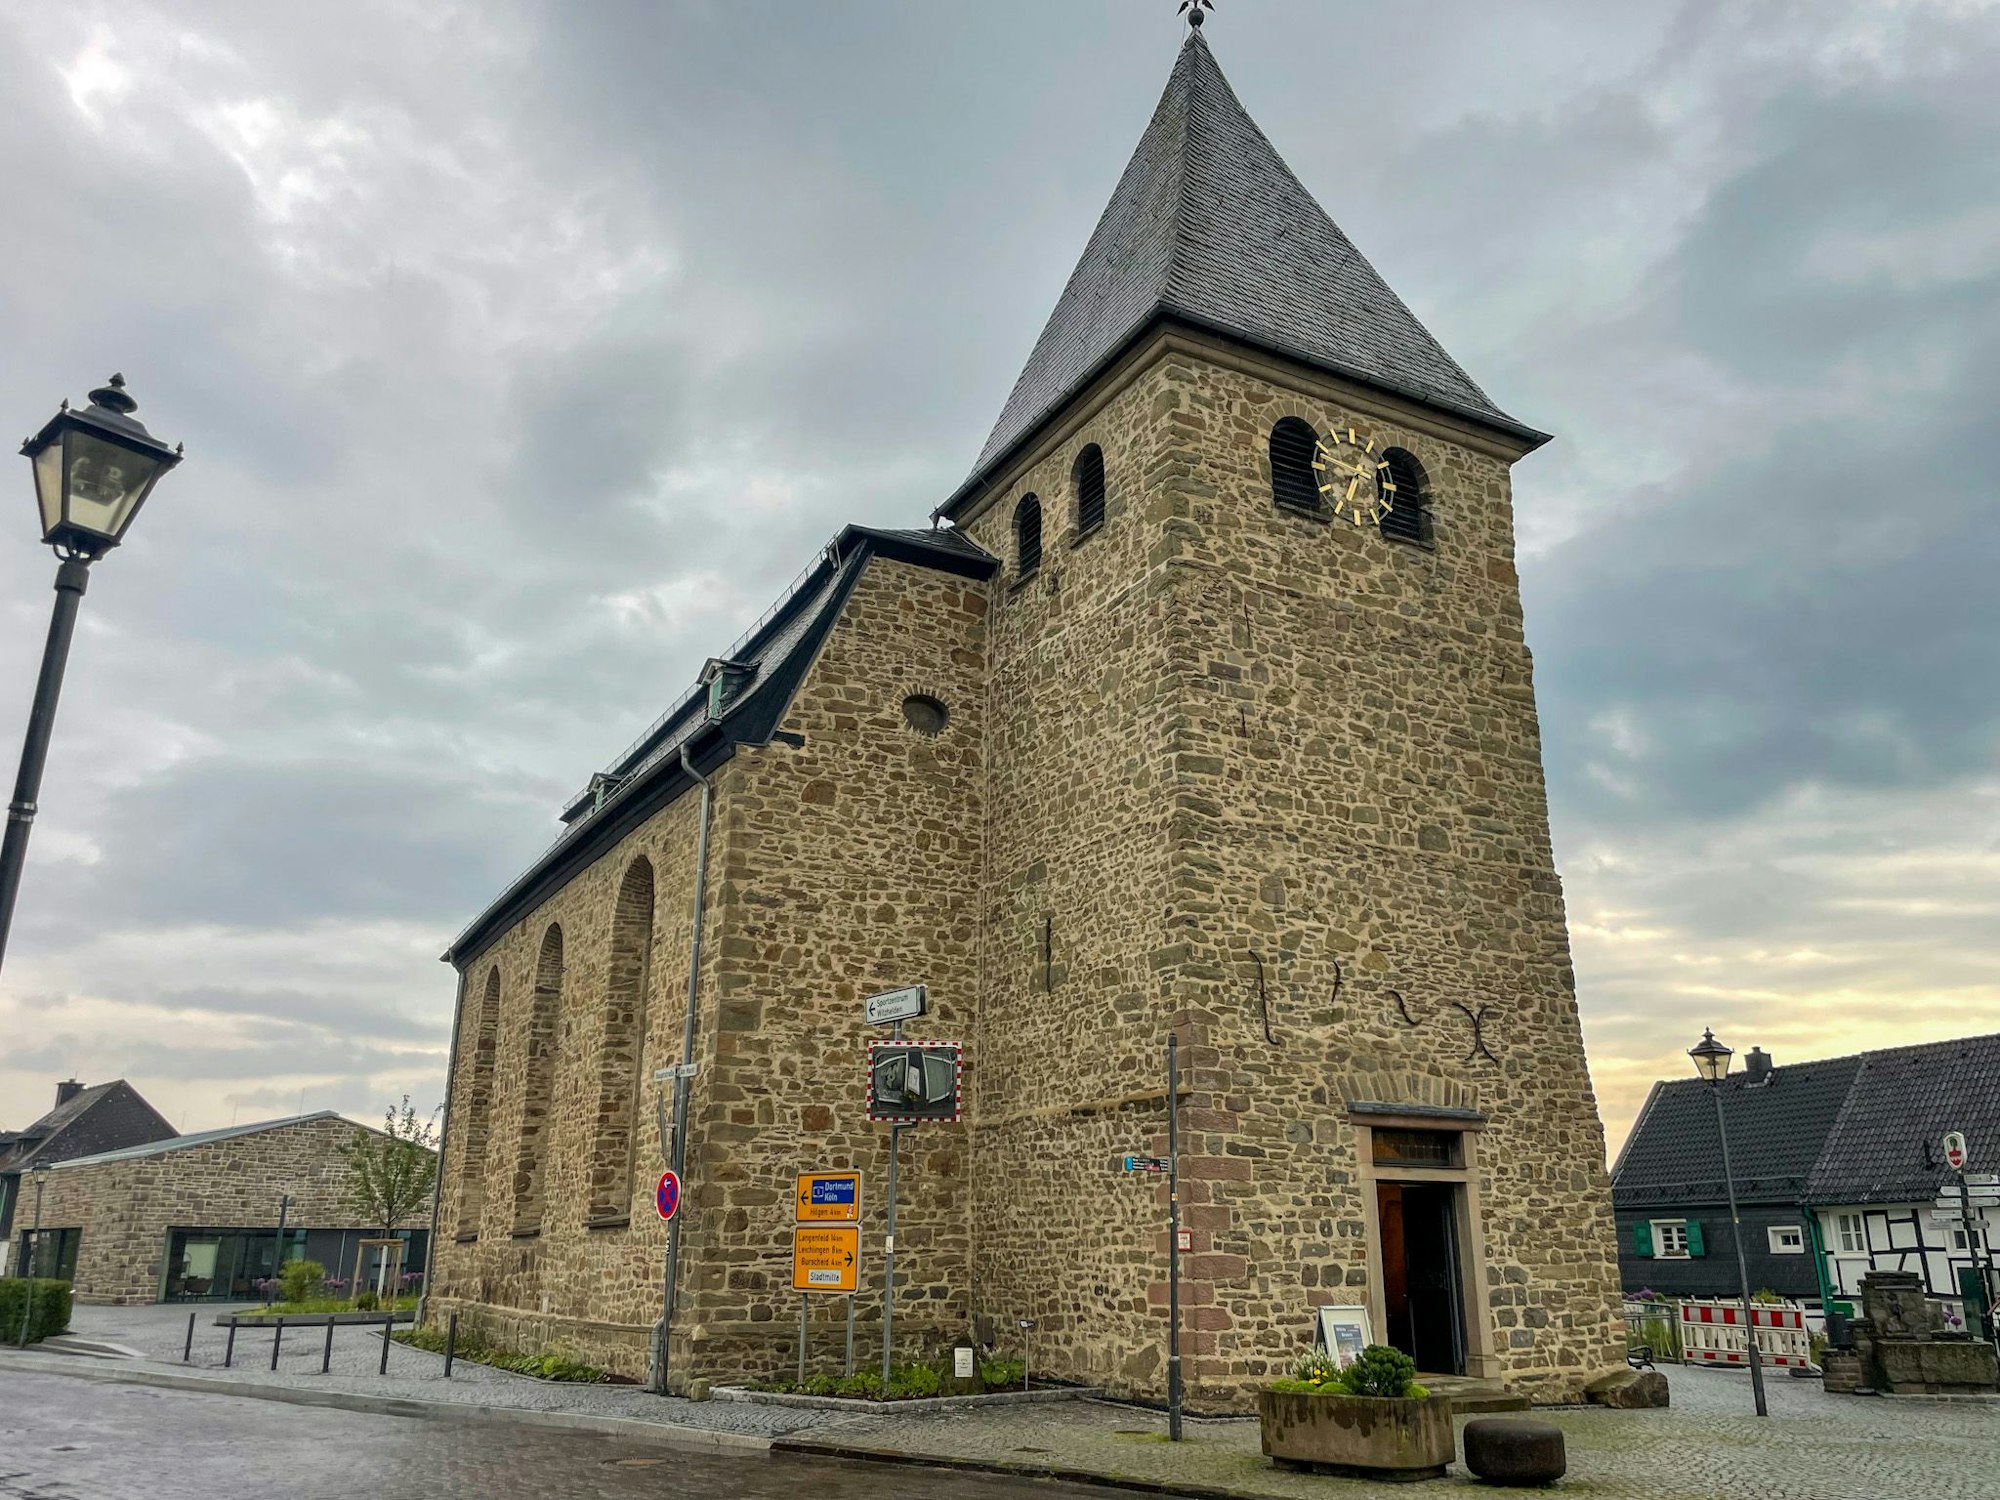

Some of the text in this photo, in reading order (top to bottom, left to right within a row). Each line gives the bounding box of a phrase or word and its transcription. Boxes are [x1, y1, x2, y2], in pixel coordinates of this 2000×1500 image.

[876, 994, 909, 1007] Sportzentrum
[876, 1006, 903, 1018] Witzhelden
[824, 1181, 854, 1191] Dortmund
[824, 1192, 838, 1202] Köln
[798, 1234, 829, 1243] Langenfeld
[798, 1245, 830, 1255] Leichlingen
[801, 1257, 829, 1266] Burscheid
[810, 1272, 840, 1282] Stadtmitte
